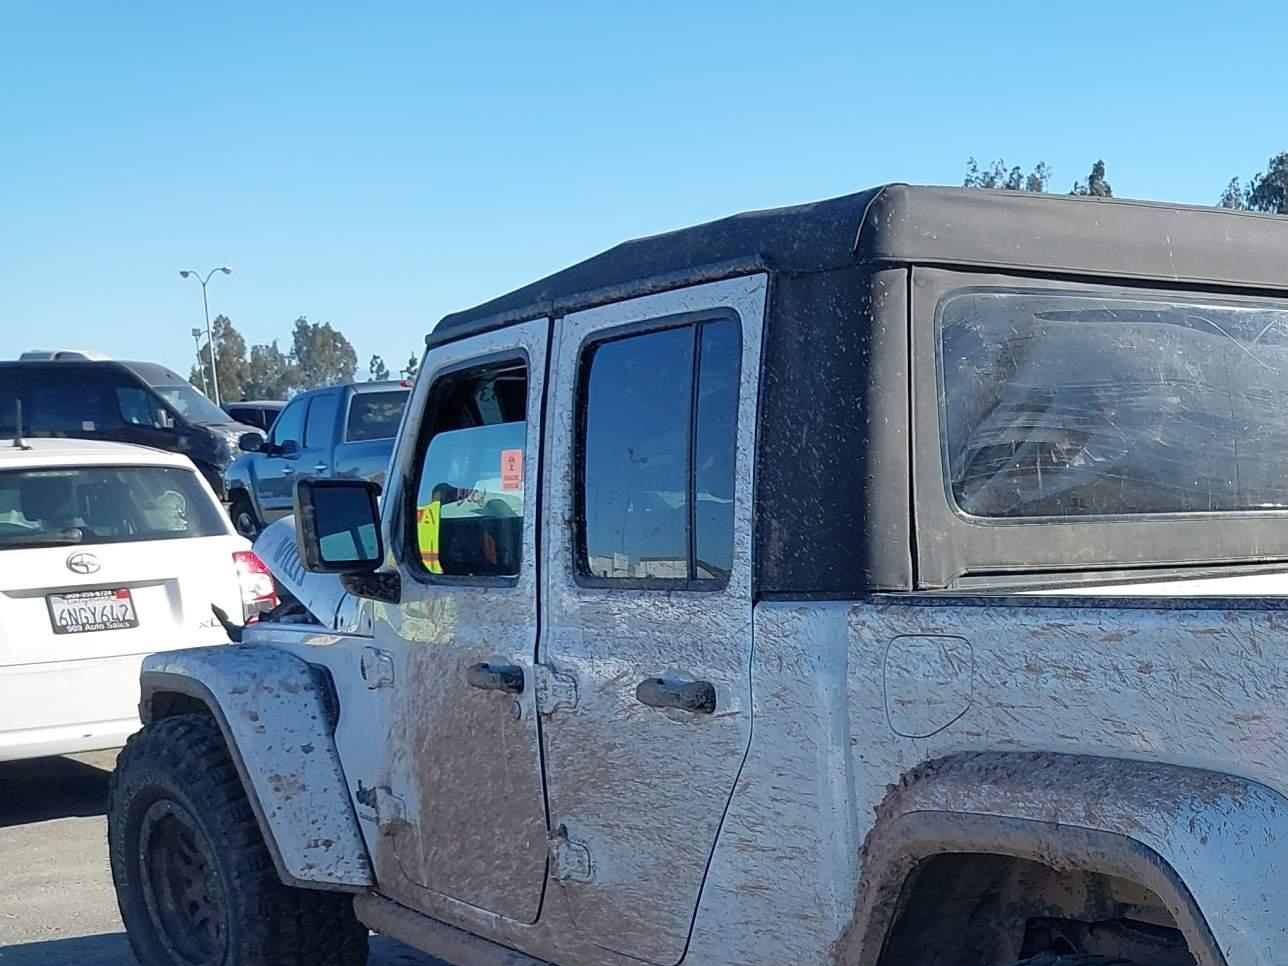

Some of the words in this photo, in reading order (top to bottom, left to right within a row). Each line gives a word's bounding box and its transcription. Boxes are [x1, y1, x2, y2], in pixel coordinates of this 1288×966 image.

[66, 623, 83, 633] 909
[85, 621, 105, 631] Auto
[106, 619, 130, 630] Sales
